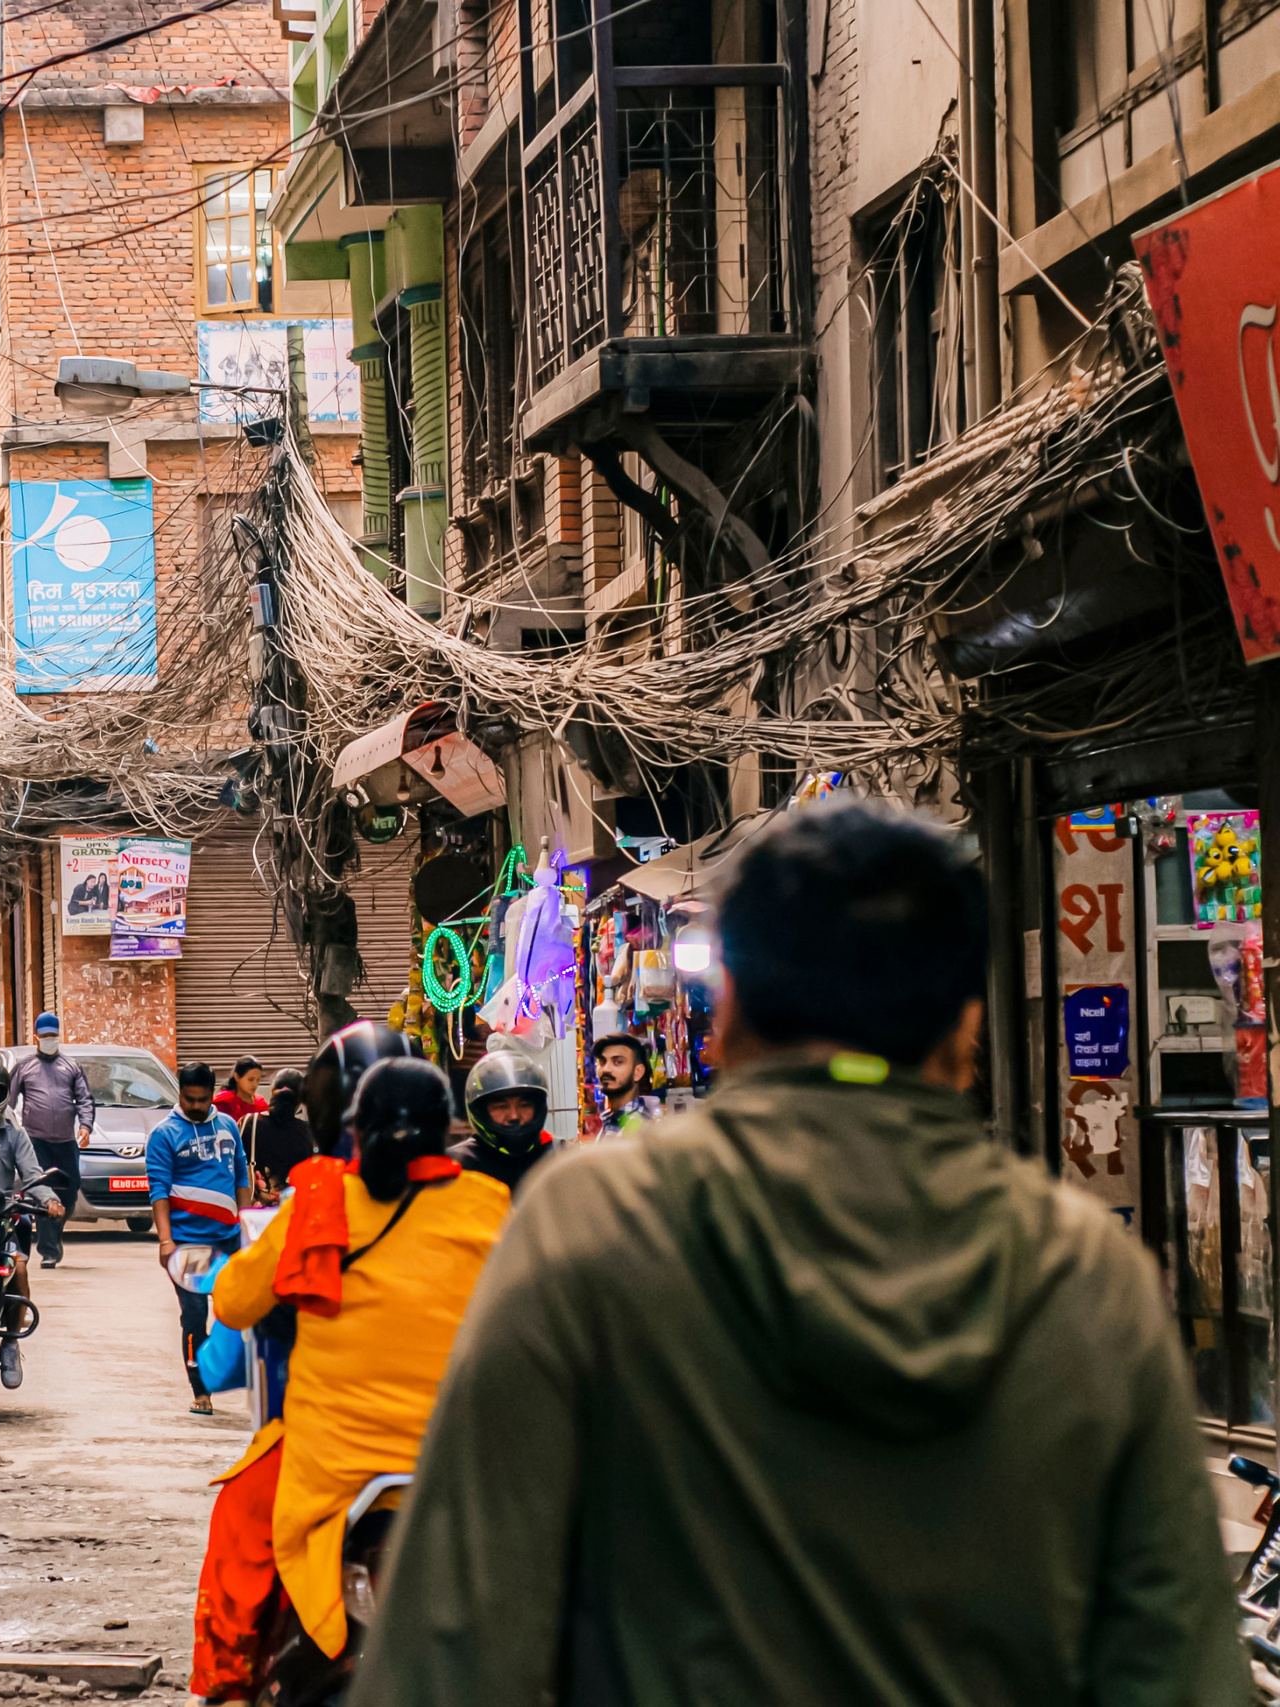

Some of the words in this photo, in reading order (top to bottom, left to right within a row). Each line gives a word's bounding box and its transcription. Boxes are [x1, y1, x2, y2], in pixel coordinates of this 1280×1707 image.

[28, 580, 63, 602] हिम
[27, 614, 55, 628] HIM
[72, 848, 111, 856] GRADE
[121, 853, 171, 869] Nursery
[147, 873, 173, 884] Class
[176, 874, 188, 885] IX
[1080, 1007, 1105, 1017] Ncell
